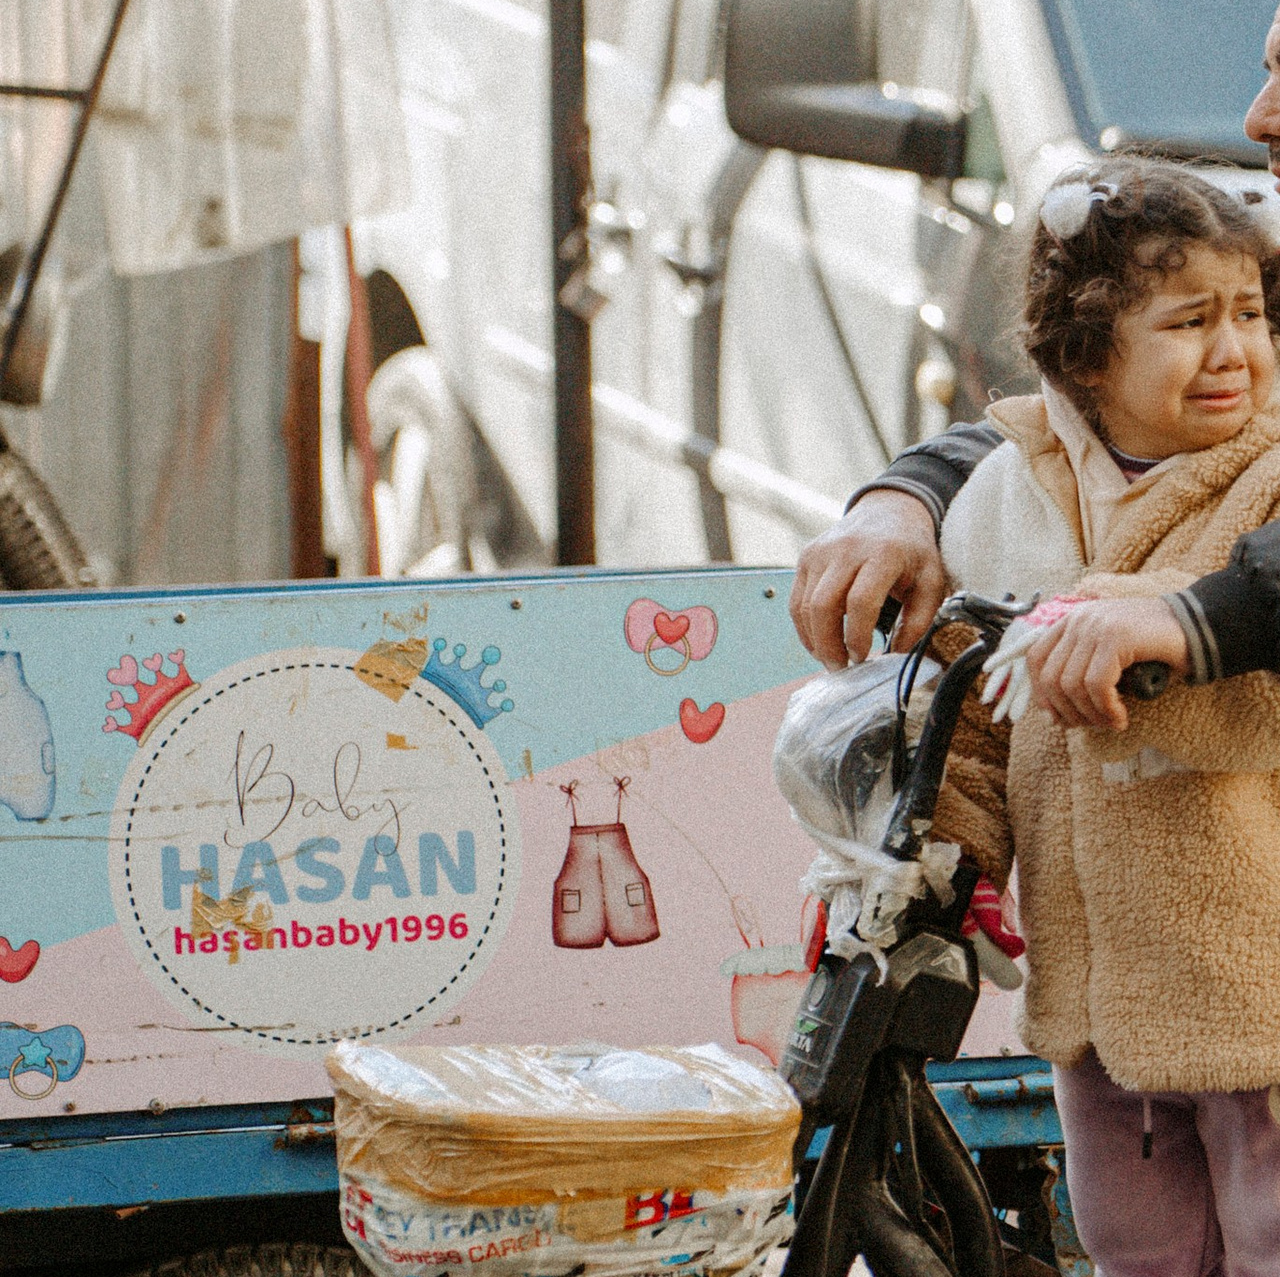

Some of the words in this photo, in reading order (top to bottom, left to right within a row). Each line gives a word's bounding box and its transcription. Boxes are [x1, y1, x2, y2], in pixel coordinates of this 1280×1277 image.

[224, 730, 412, 857] Baby
[161, 830, 477, 910] HASAN
[174, 912, 470, 955] hasanbaby1996
